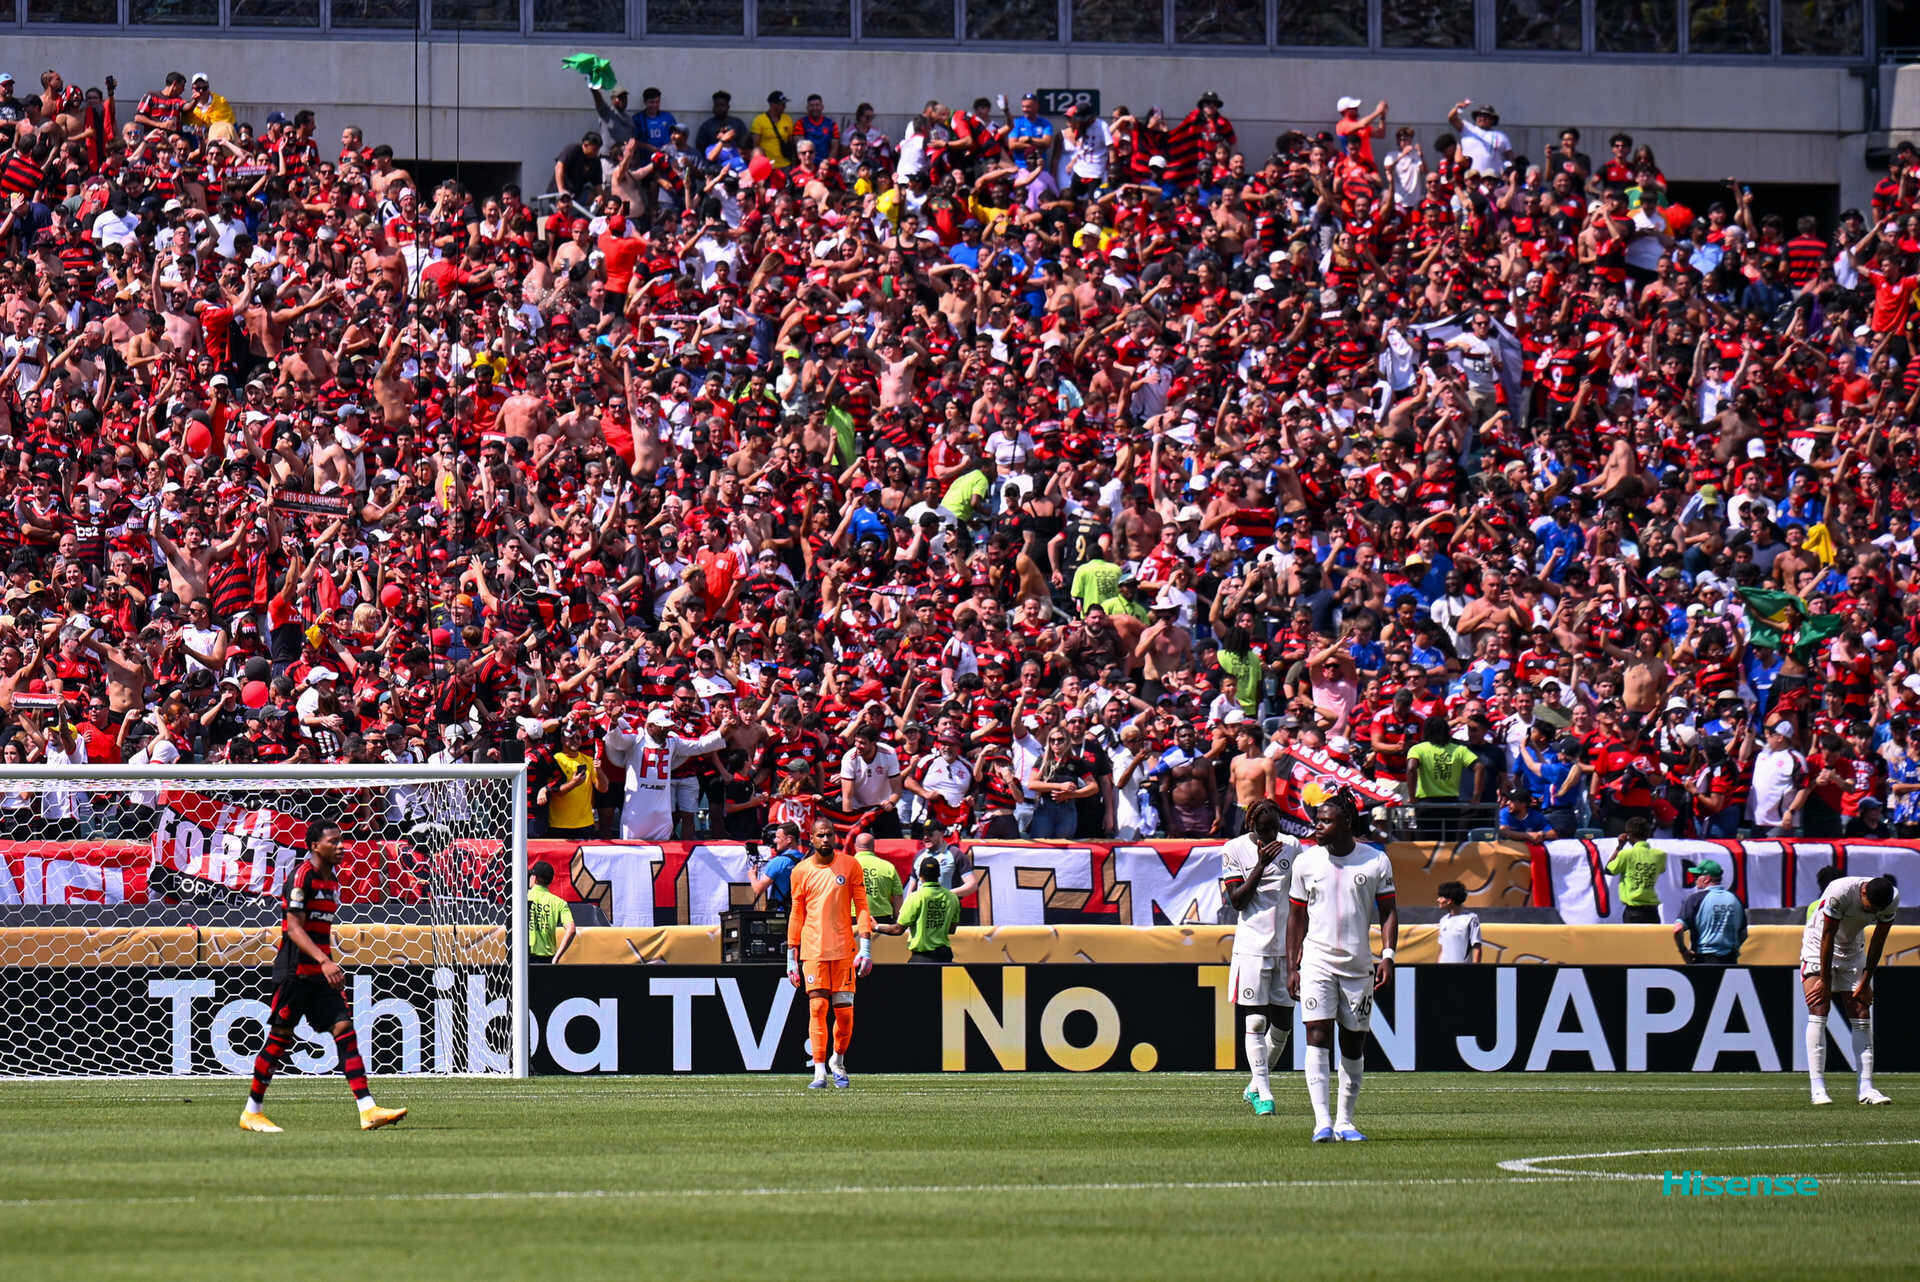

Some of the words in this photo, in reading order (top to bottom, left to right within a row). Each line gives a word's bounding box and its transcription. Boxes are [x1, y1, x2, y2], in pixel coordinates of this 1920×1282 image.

[1044, 92, 1091, 113] 128
[1075, 534, 1087, 561] 9
[640, 747, 670, 780] FE
[863, 867, 877, 877] SC
[149, 968, 619, 1074] Toshiba
[649, 977, 815, 1072] TV
[941, 966, 1158, 1071] No.
[1198, 966, 1236, 1070] 1
